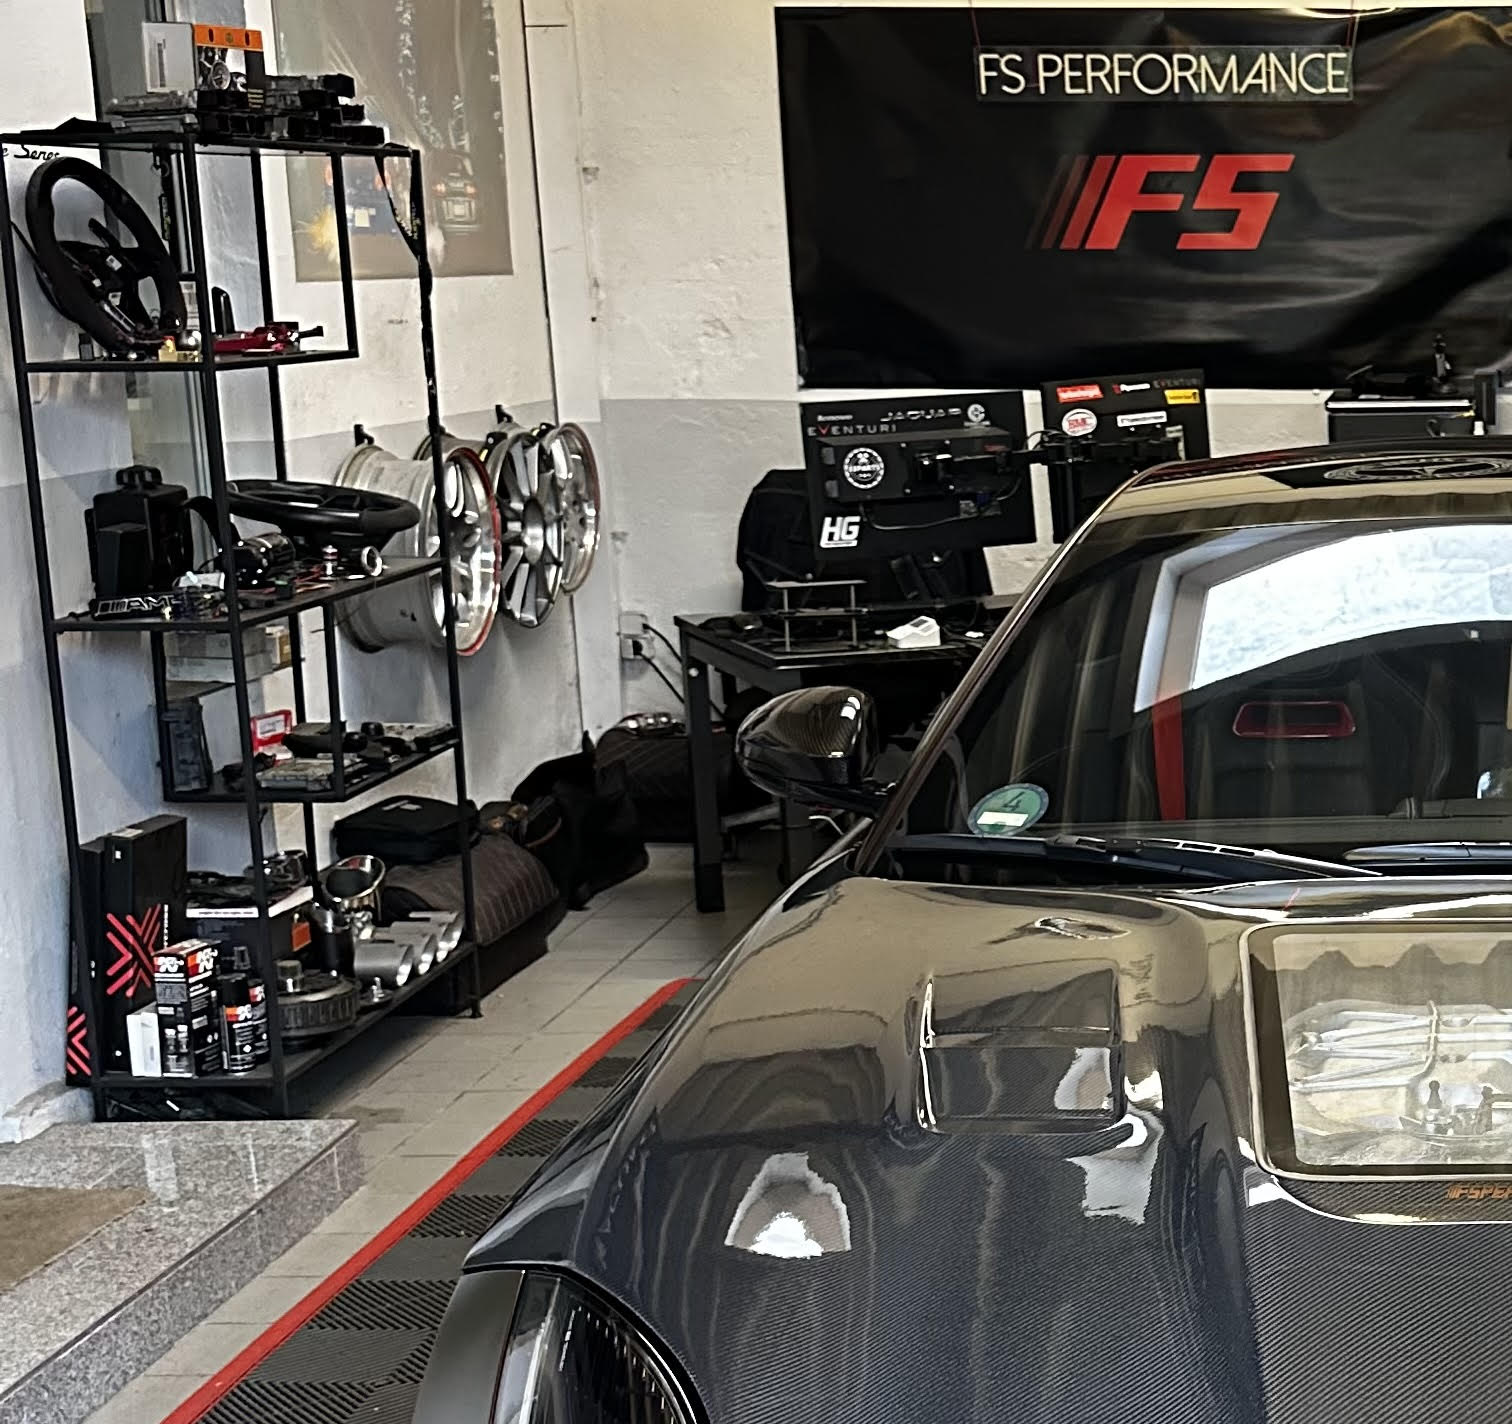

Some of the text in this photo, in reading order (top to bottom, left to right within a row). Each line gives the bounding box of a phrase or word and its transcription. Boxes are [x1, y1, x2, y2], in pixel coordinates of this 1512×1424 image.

[979, 52, 1350, 94] FS PERFORMANCE
[1084, 154, 1296, 250] FS
[807, 423, 897, 436] EVENTURI
[820, 515, 861, 548] HG
[1001, 790, 1026, 812] 4
